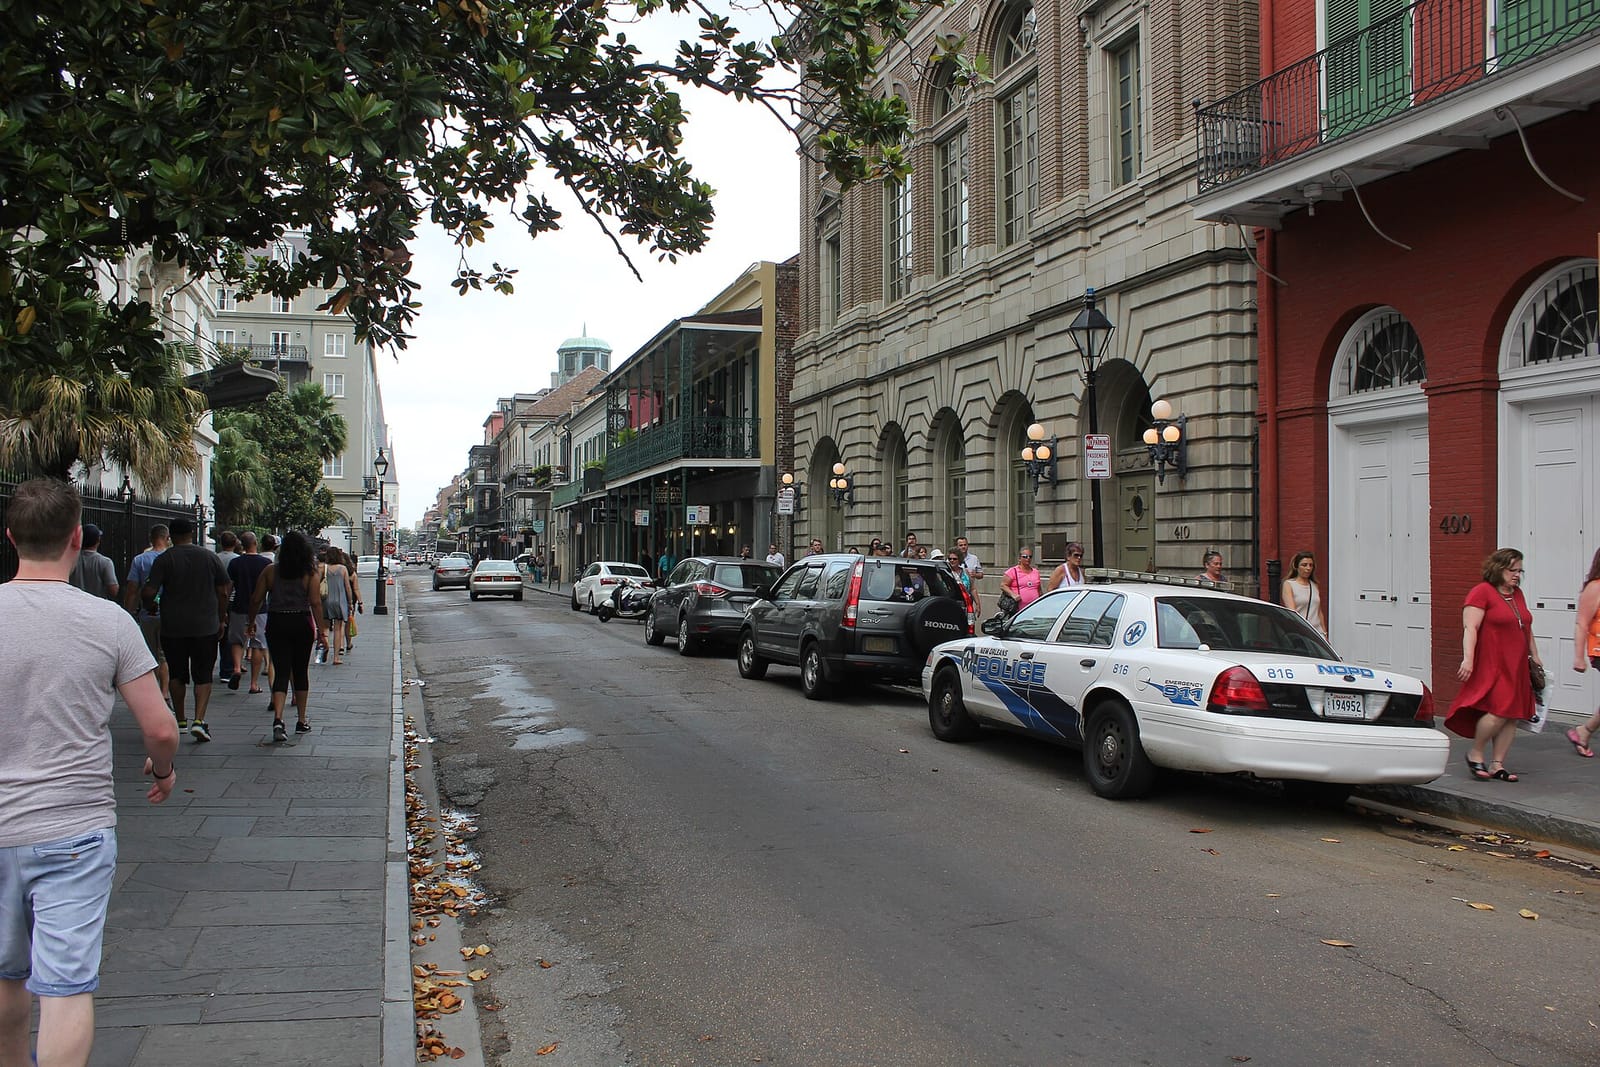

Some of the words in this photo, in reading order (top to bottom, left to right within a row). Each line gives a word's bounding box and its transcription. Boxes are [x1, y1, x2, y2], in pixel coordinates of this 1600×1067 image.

[1440, 514, 1471, 534] 400
[1174, 525, 1190, 539] 410
[925, 621, 960, 631] HONDA
[989, 648, 1008, 656] ORLEANS
[977, 656, 1047, 687] POLICE
[1113, 663, 1129, 675] 816
[1267, 668, 1294, 679] 816
[1317, 664, 1375, 678] NOPD
[1164, 680, 1204, 688] EMERGENCY
[1163, 685, 1203, 702] 911
[1332, 699, 1362, 713] 194952
